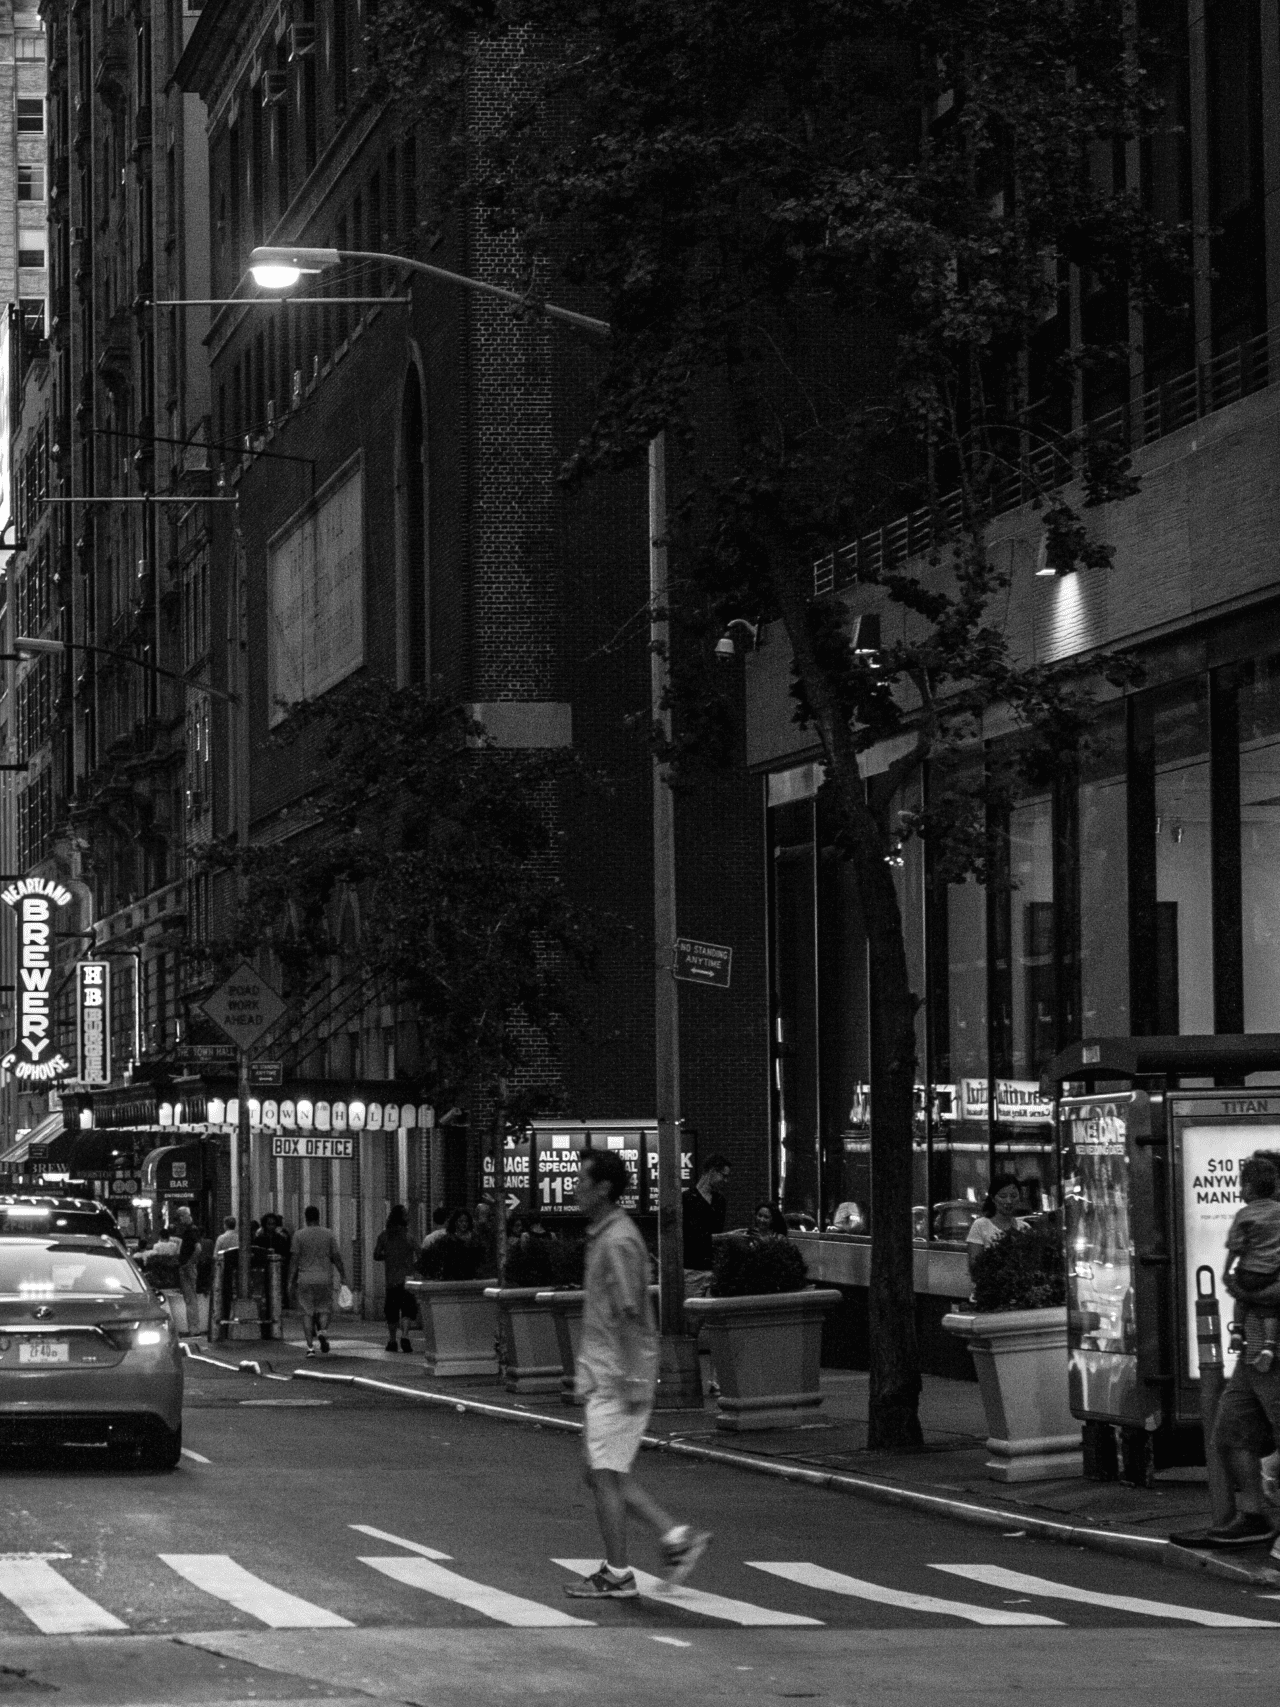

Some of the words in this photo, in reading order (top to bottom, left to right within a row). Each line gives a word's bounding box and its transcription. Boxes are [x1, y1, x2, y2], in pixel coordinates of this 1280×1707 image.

[1, 878, 72, 906] HEARTLAND
[681, 943, 691, 952] NO
[694, 945, 728, 960] STANDING
[686, 955, 722, 969] ANYTIME
[20, 898, 52, 1061] BREWERY
[228, 985, 260, 996] ROAD
[228, 1001, 259, 1010] WORK
[224, 1015, 263, 1025] AHEAD
[83, 1008, 104, 1082] BURGER
[1, 1054, 70, 1081] COPHOUSE
[1222, 1100, 1268, 1113] TITAN
[335, 1110, 395, 1123] HALL
[274, 1138, 300, 1155] BOX
[305, 1138, 351, 1156] OFFICE
[539, 1151, 559, 1161] ALL
[647, 1152, 694, 1168] PK
[483, 1156, 530, 1173] GAGE
[1208, 1158, 1234, 1173] $10
[170, 1180, 189, 1188] BAR
[483, 1175, 530, 1188] ENANCE
[1192, 1175, 1239, 1189] ANYW
